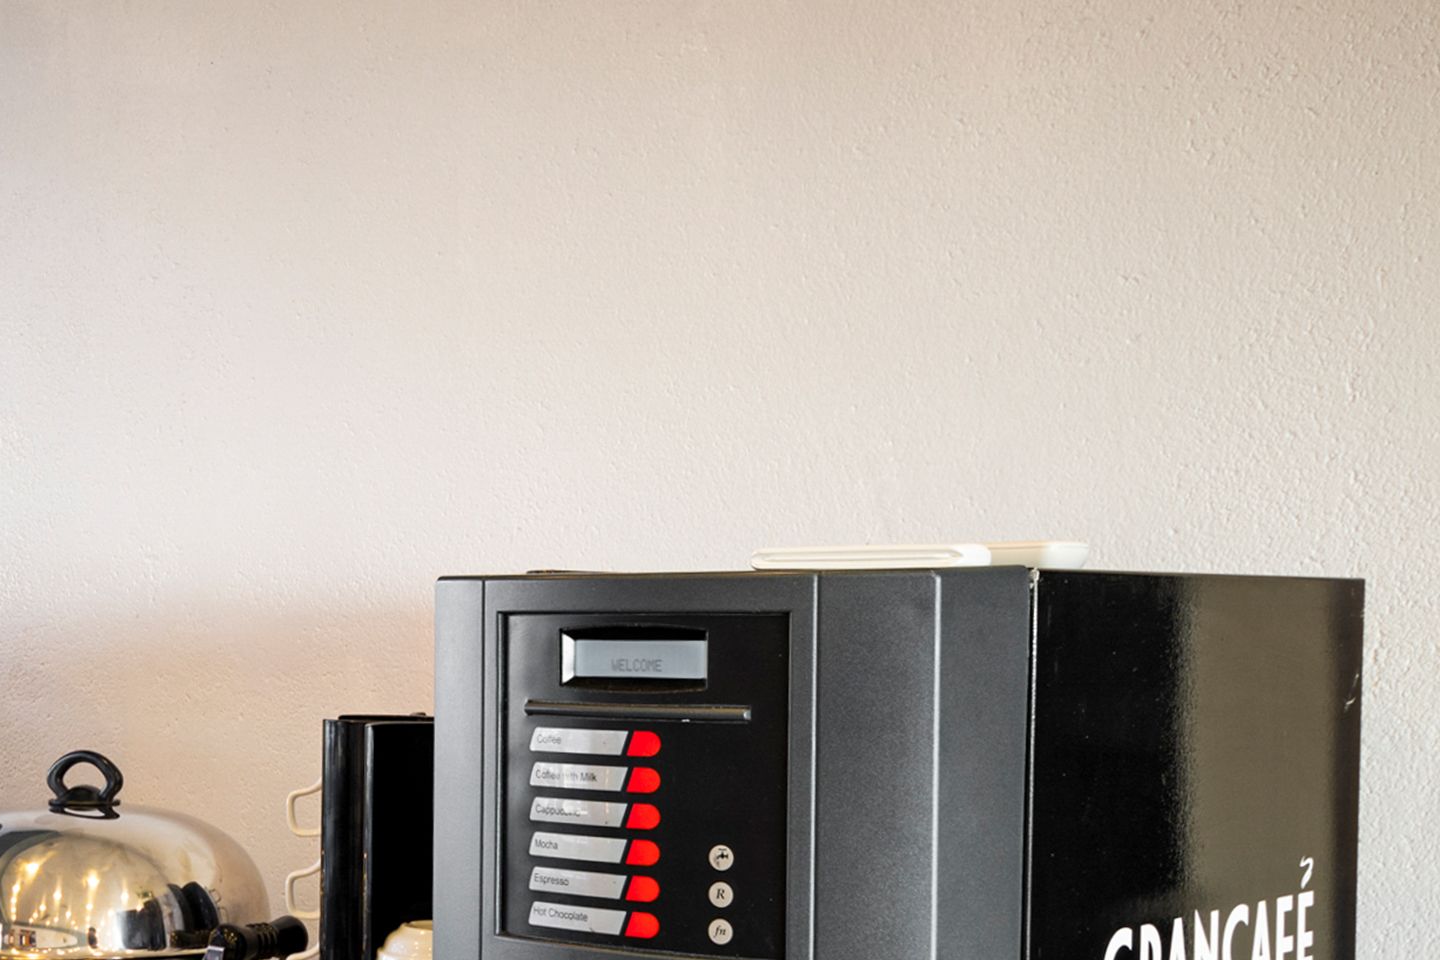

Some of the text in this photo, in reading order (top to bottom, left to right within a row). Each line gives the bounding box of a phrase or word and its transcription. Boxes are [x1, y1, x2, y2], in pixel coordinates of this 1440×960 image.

[610, 658, 663, 672] WELCOME
[536, 734, 562, 745] Coffee
[580, 771, 597, 783] Milk
[534, 838, 559, 850] Mocha
[533, 873, 570, 887] Espresso
[716, 888, 725, 900] R
[533, 906, 589, 922] Hot Chocolate
